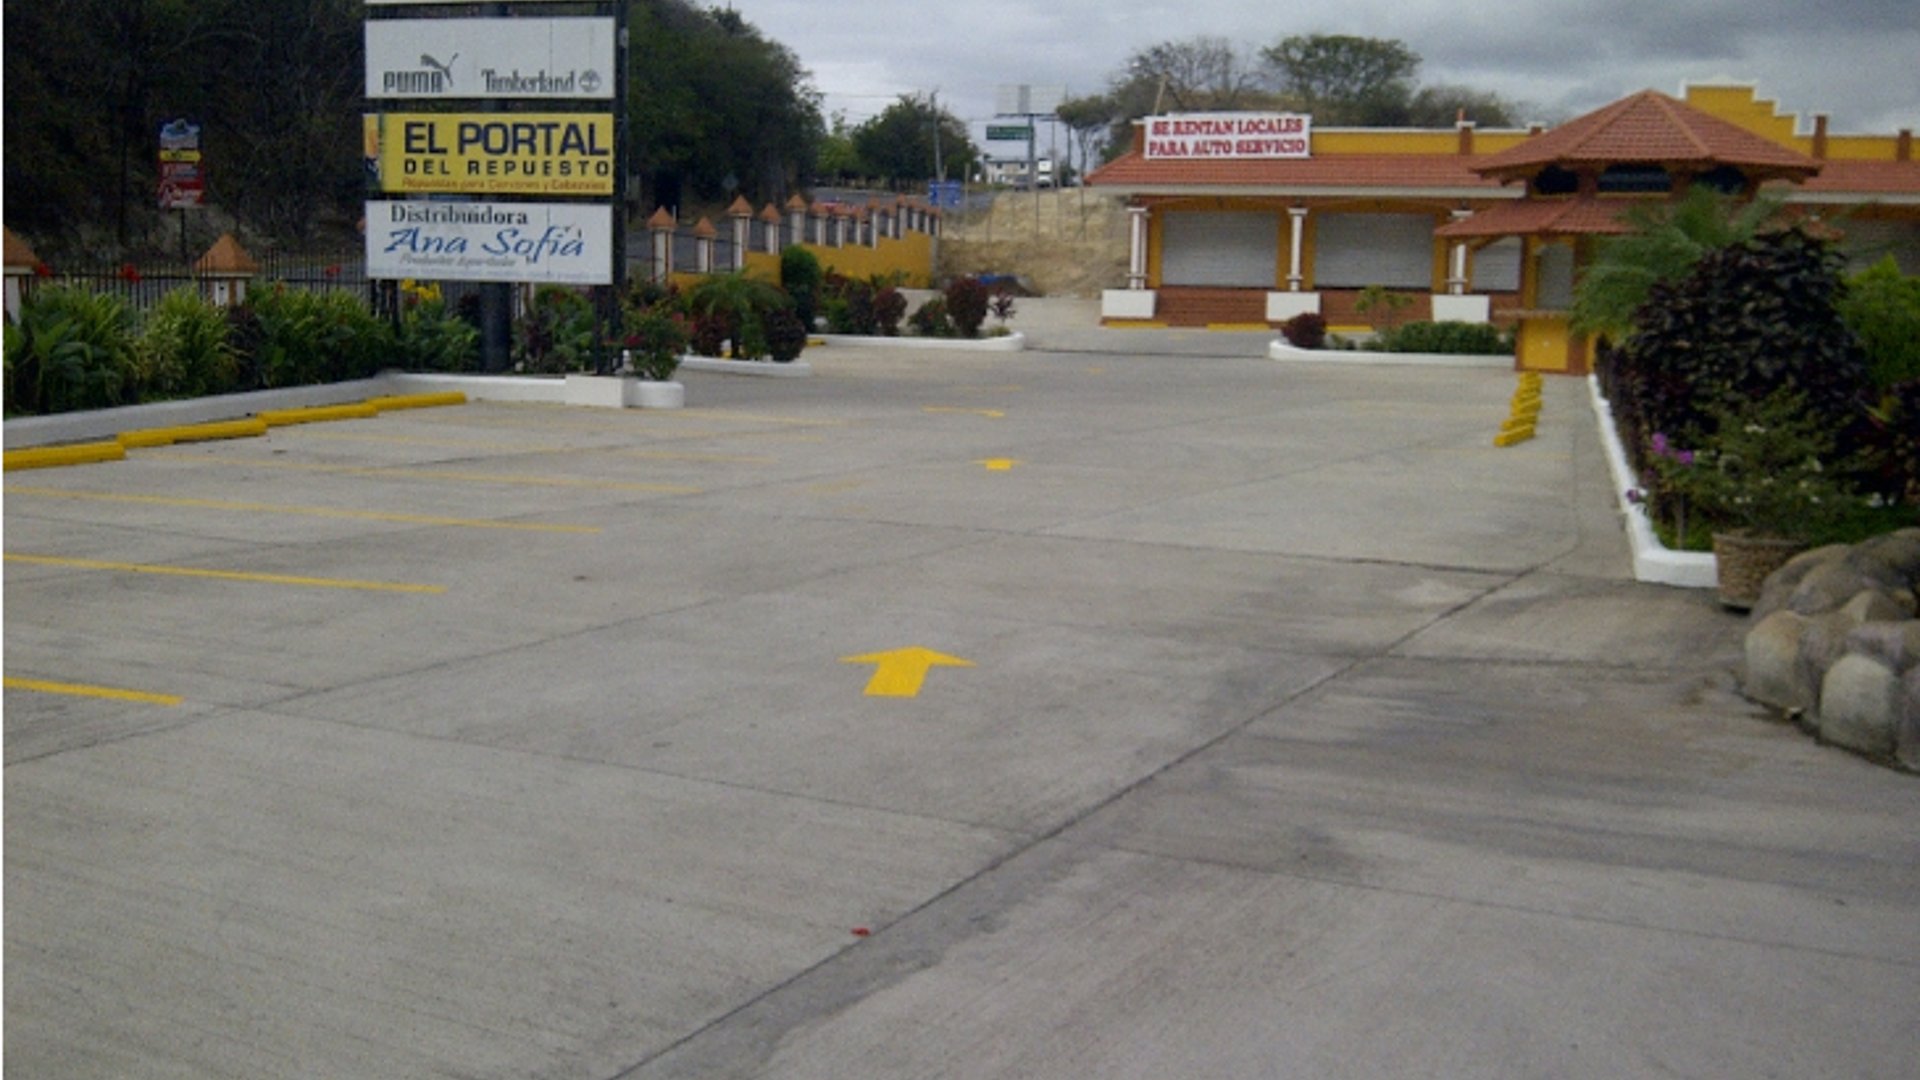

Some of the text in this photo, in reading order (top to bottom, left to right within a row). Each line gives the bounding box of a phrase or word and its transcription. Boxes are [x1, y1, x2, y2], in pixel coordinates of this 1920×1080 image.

[383, 69, 576, 93] PUMA Timberland
[1152, 118, 1303, 135] SE RENTAN LOCALES
[404, 122, 609, 156] EL PORTAL
[1150, 139, 1306, 156] PARA AUTO SERVICIO
[404, 160, 610, 176] DEL REPUESTO
[391, 205, 528, 224] Distribuidora
[384, 227, 468, 253] Ana
